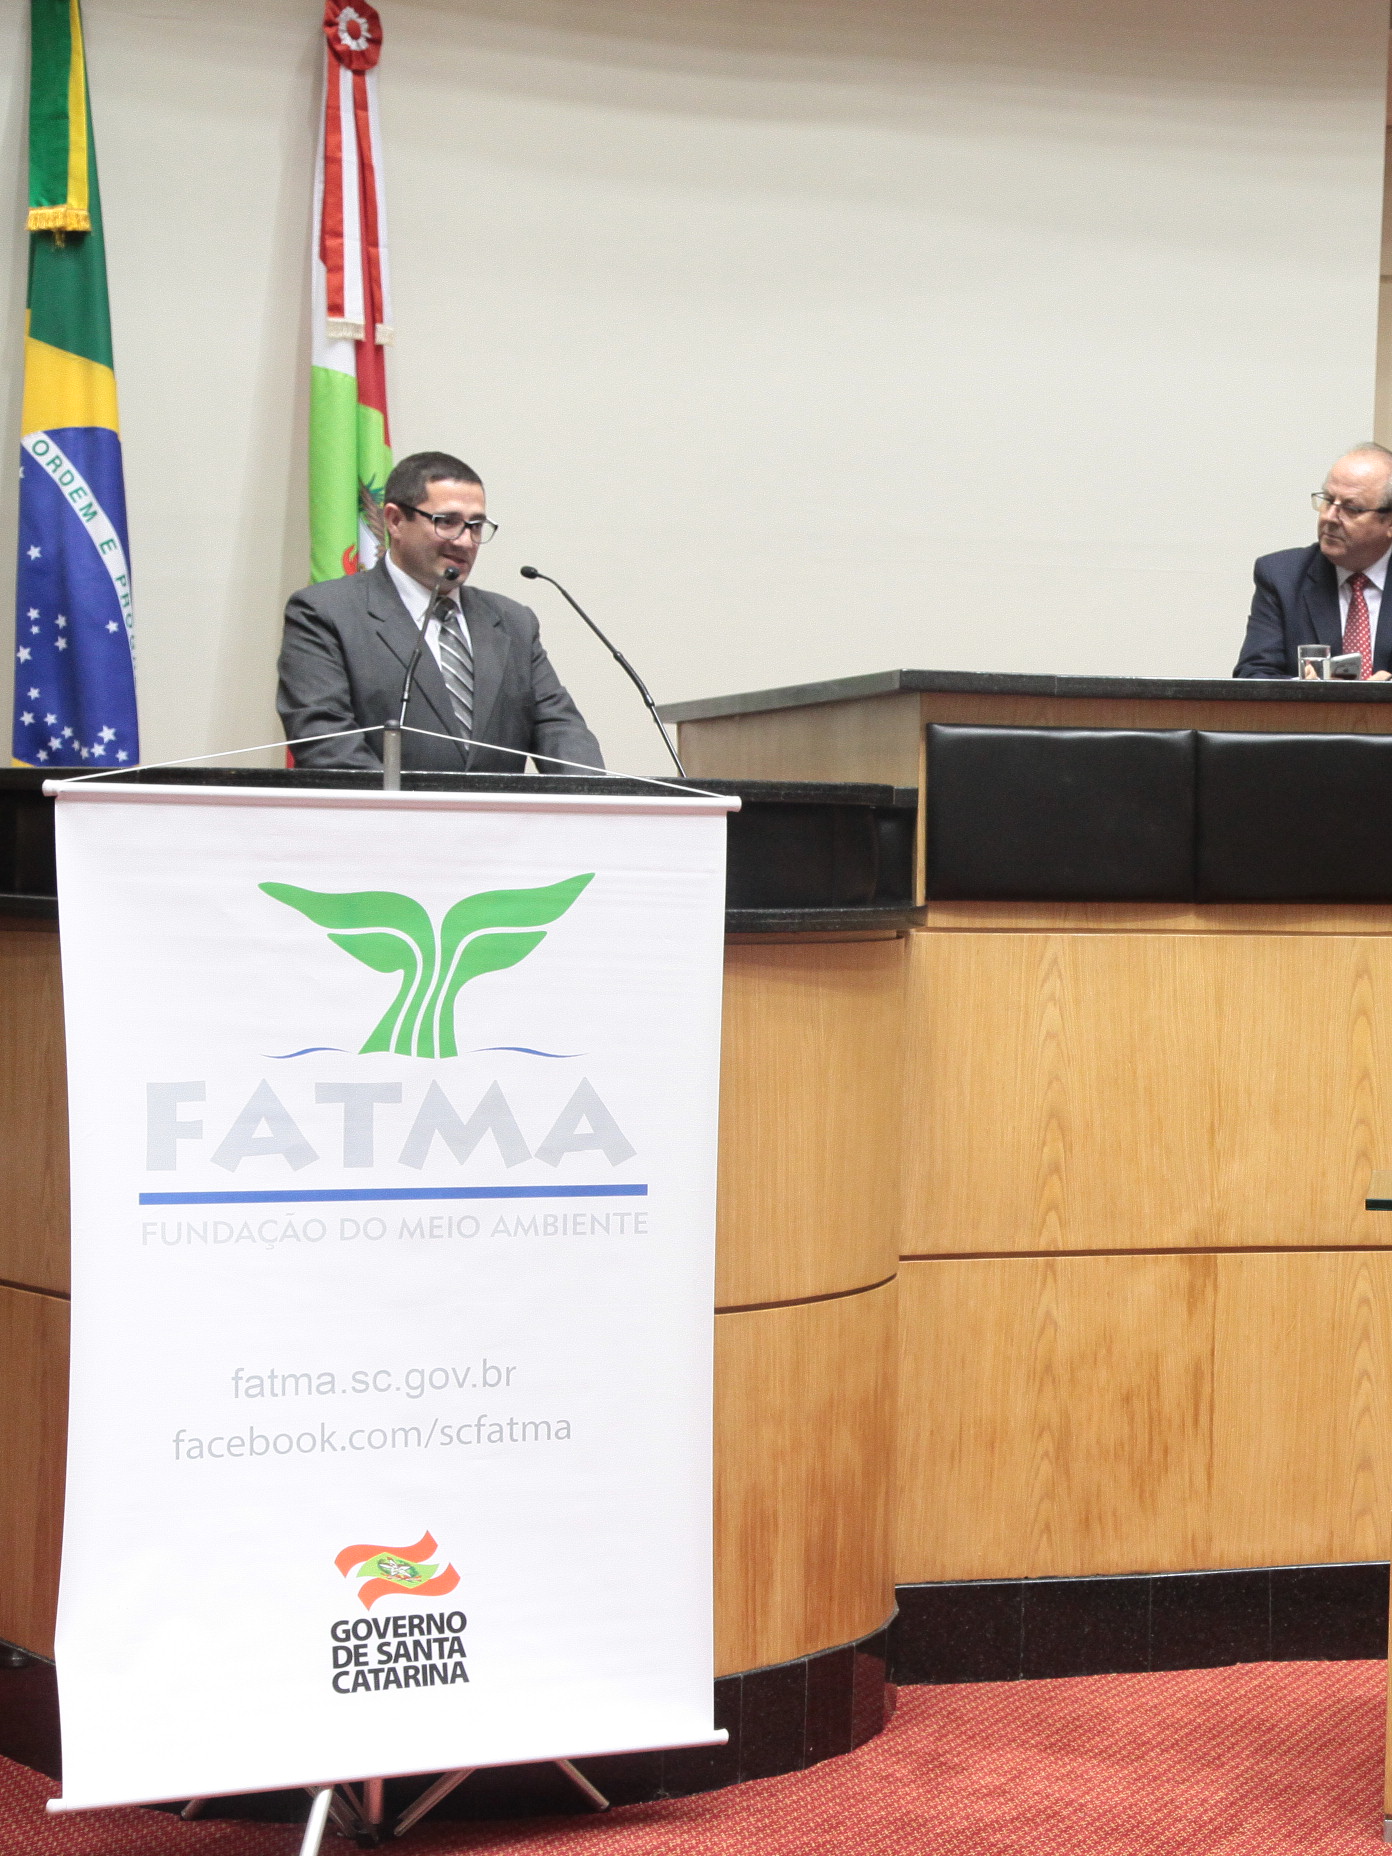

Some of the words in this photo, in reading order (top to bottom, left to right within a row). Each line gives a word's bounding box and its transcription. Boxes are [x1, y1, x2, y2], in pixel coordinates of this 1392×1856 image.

[31, 439, 98, 522] ORDEM
[99, 538, 117, 555] E
[146, 1076, 638, 1173] FATMA
[141, 1212, 327, 1250] FUNDAÇÃO
[339, 1216, 387, 1241] DO
[397, 1214, 480, 1240] MEIO
[490, 1211, 649, 1239] AMBIENTE
[231, 1358, 517, 1399] fatma.sc.gov.br
[172, 1414, 572, 1460] facebook.com/scfatma
[330, 1611, 467, 1643] GOVERNO
[332, 1644, 369, 1669] DE
[376, 1636, 467, 1665] SANTA
[331, 1661, 470, 1694] CATARINA
